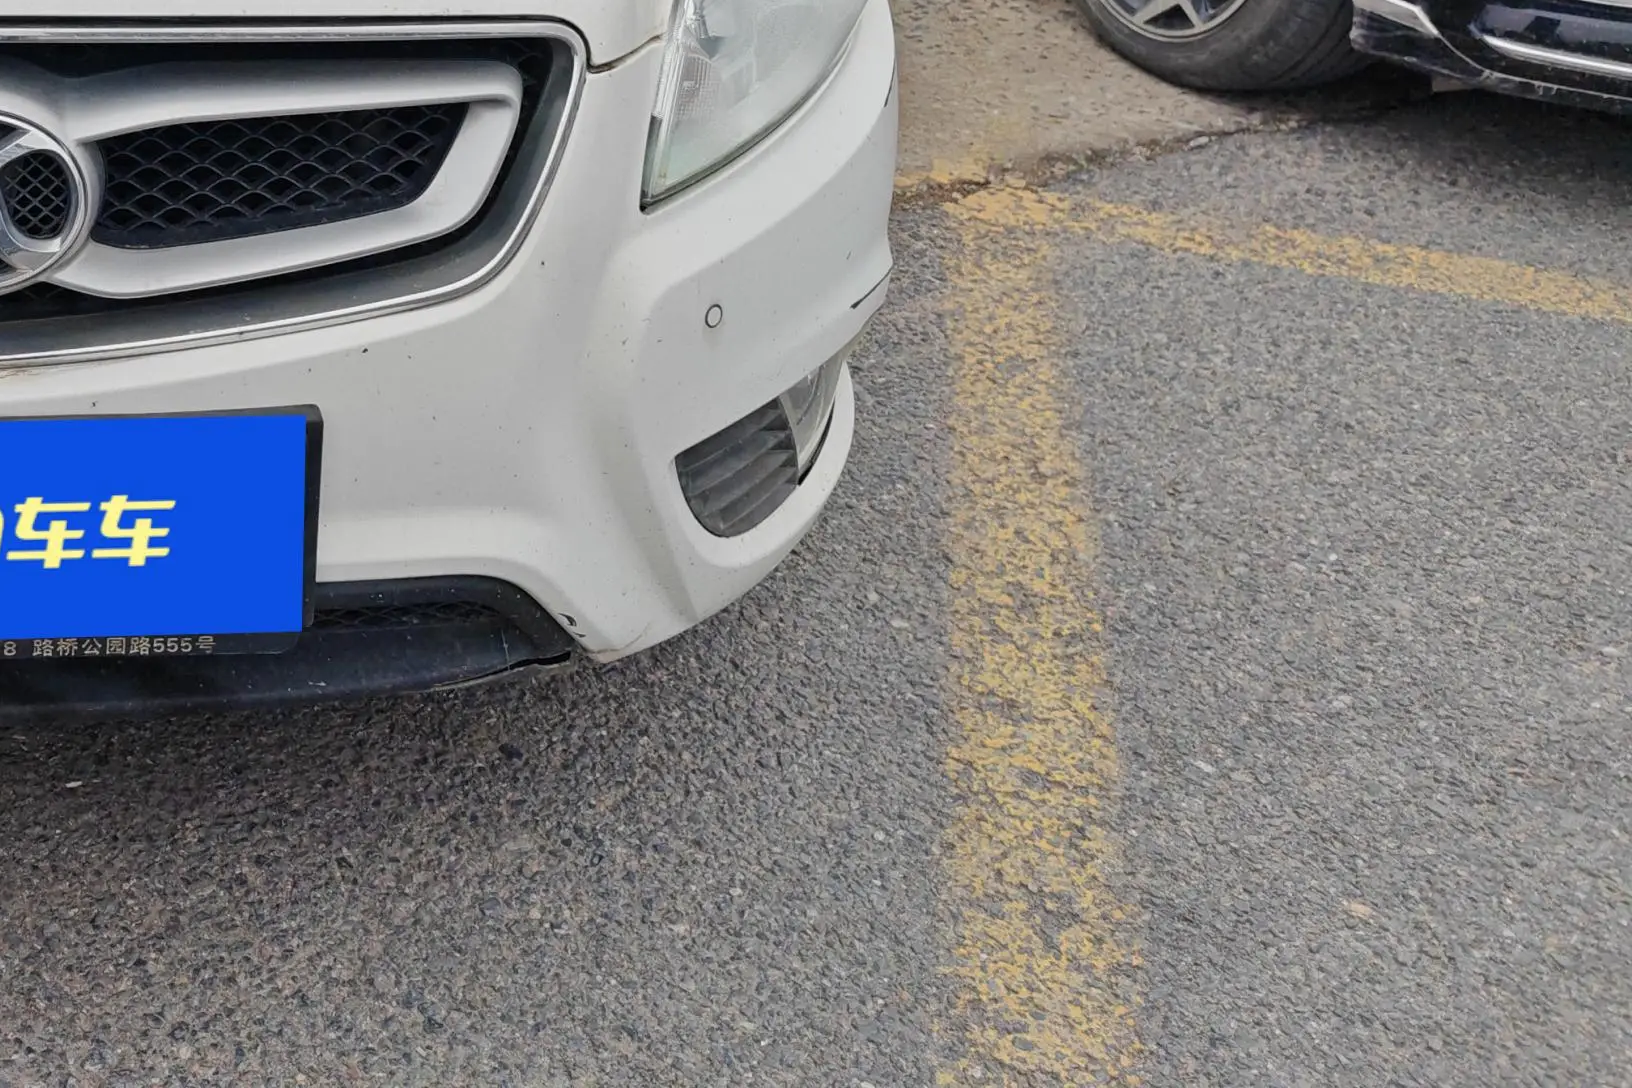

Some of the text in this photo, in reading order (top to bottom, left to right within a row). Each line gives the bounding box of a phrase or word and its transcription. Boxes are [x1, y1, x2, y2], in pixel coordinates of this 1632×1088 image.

[32, 635, 216, 657] 路桥公园路555号
